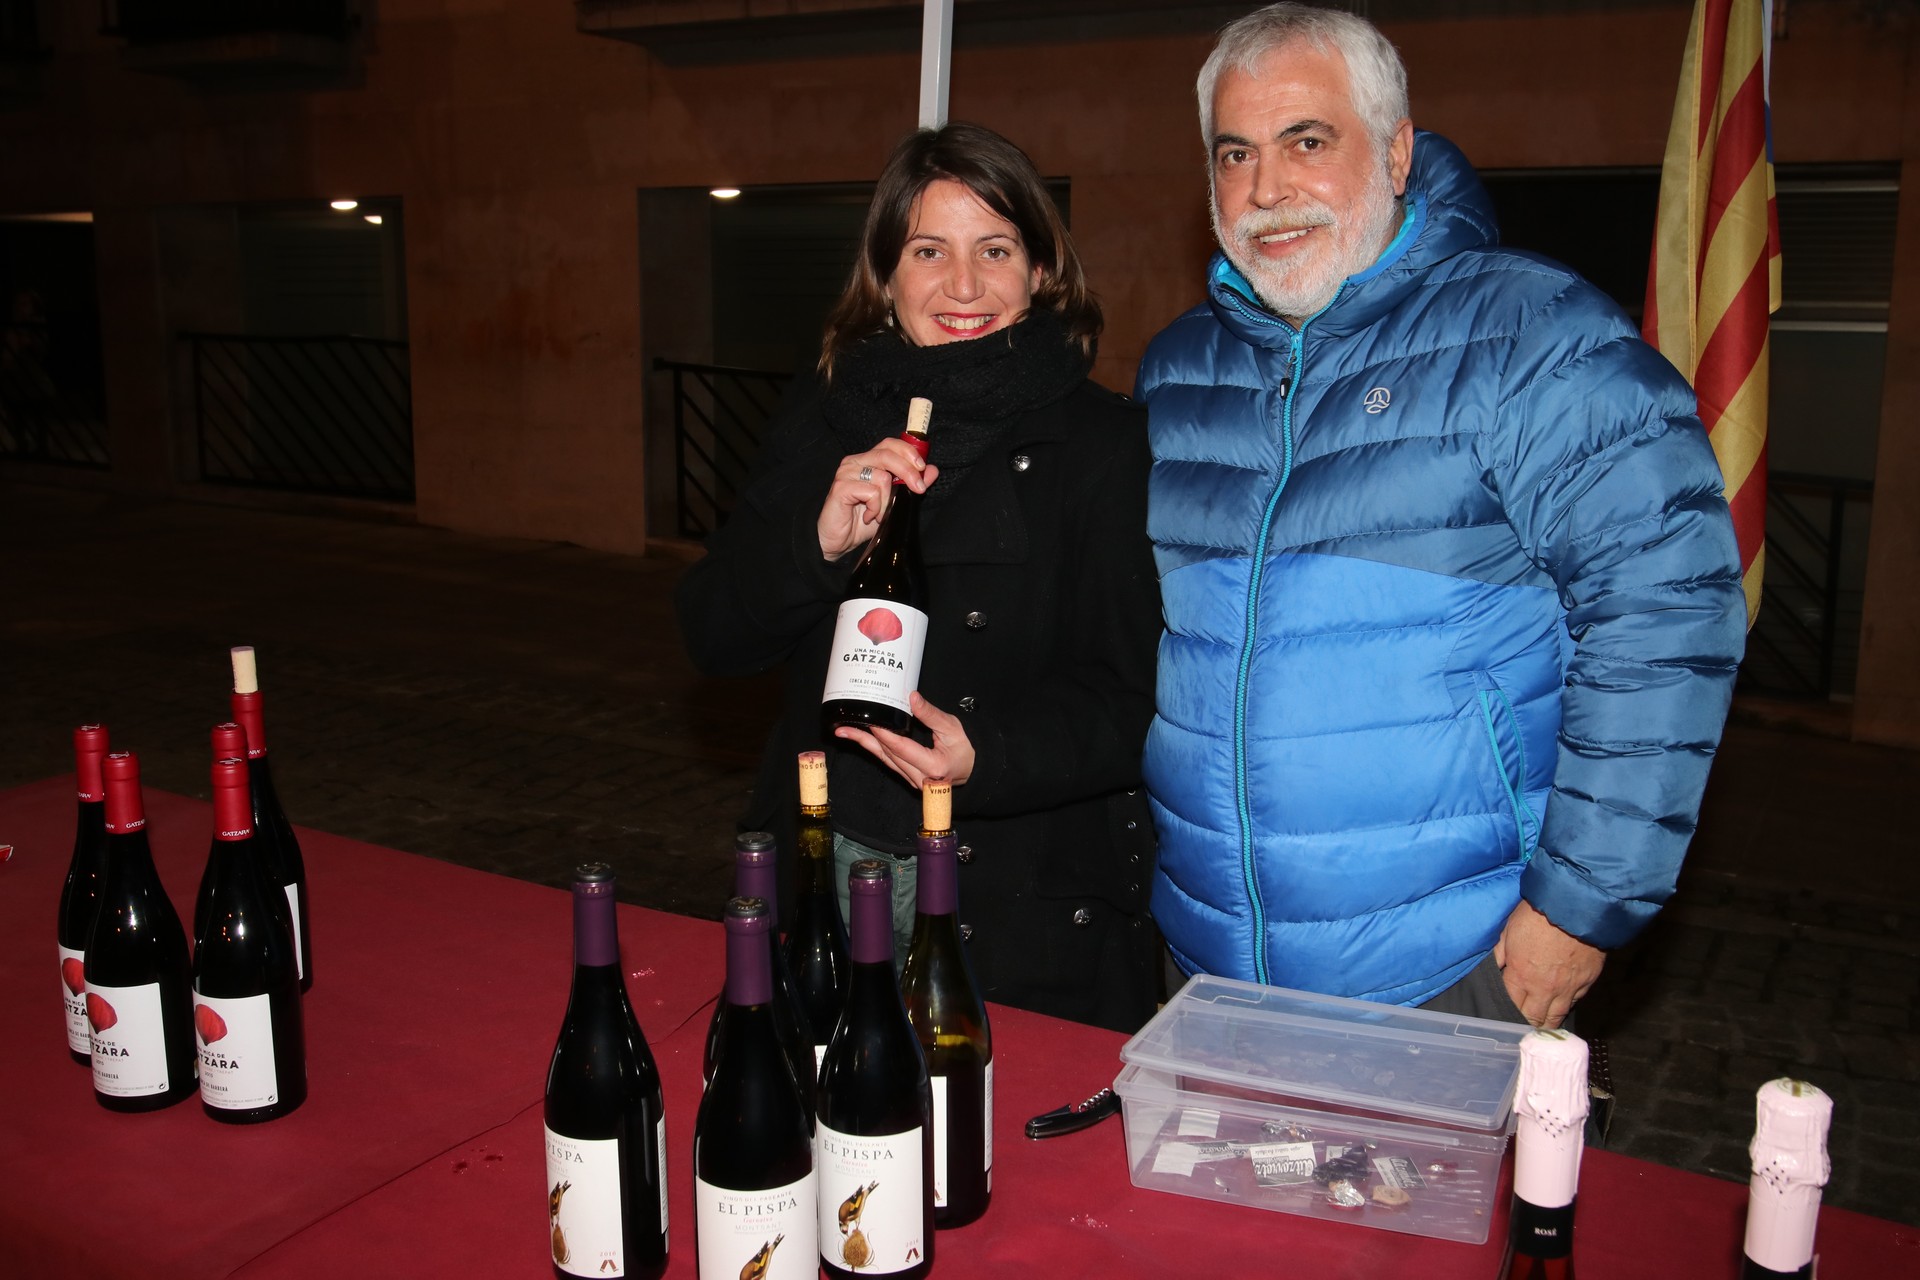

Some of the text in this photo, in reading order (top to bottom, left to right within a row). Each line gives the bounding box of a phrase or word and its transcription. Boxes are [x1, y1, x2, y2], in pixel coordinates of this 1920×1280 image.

[843, 654, 904, 670] GATZARA
[930, 787, 950, 795] VINOS
[65, 1003, 88, 1016] ATZA
[91, 1043, 129, 1057] TZARA
[199, 1053, 239, 1069] TZARA
[824, 1139, 894, 1161] EL PISPA
[760, 1191, 792, 1201] PASEANTE
[718, 1197, 798, 1216] EL PISPA
